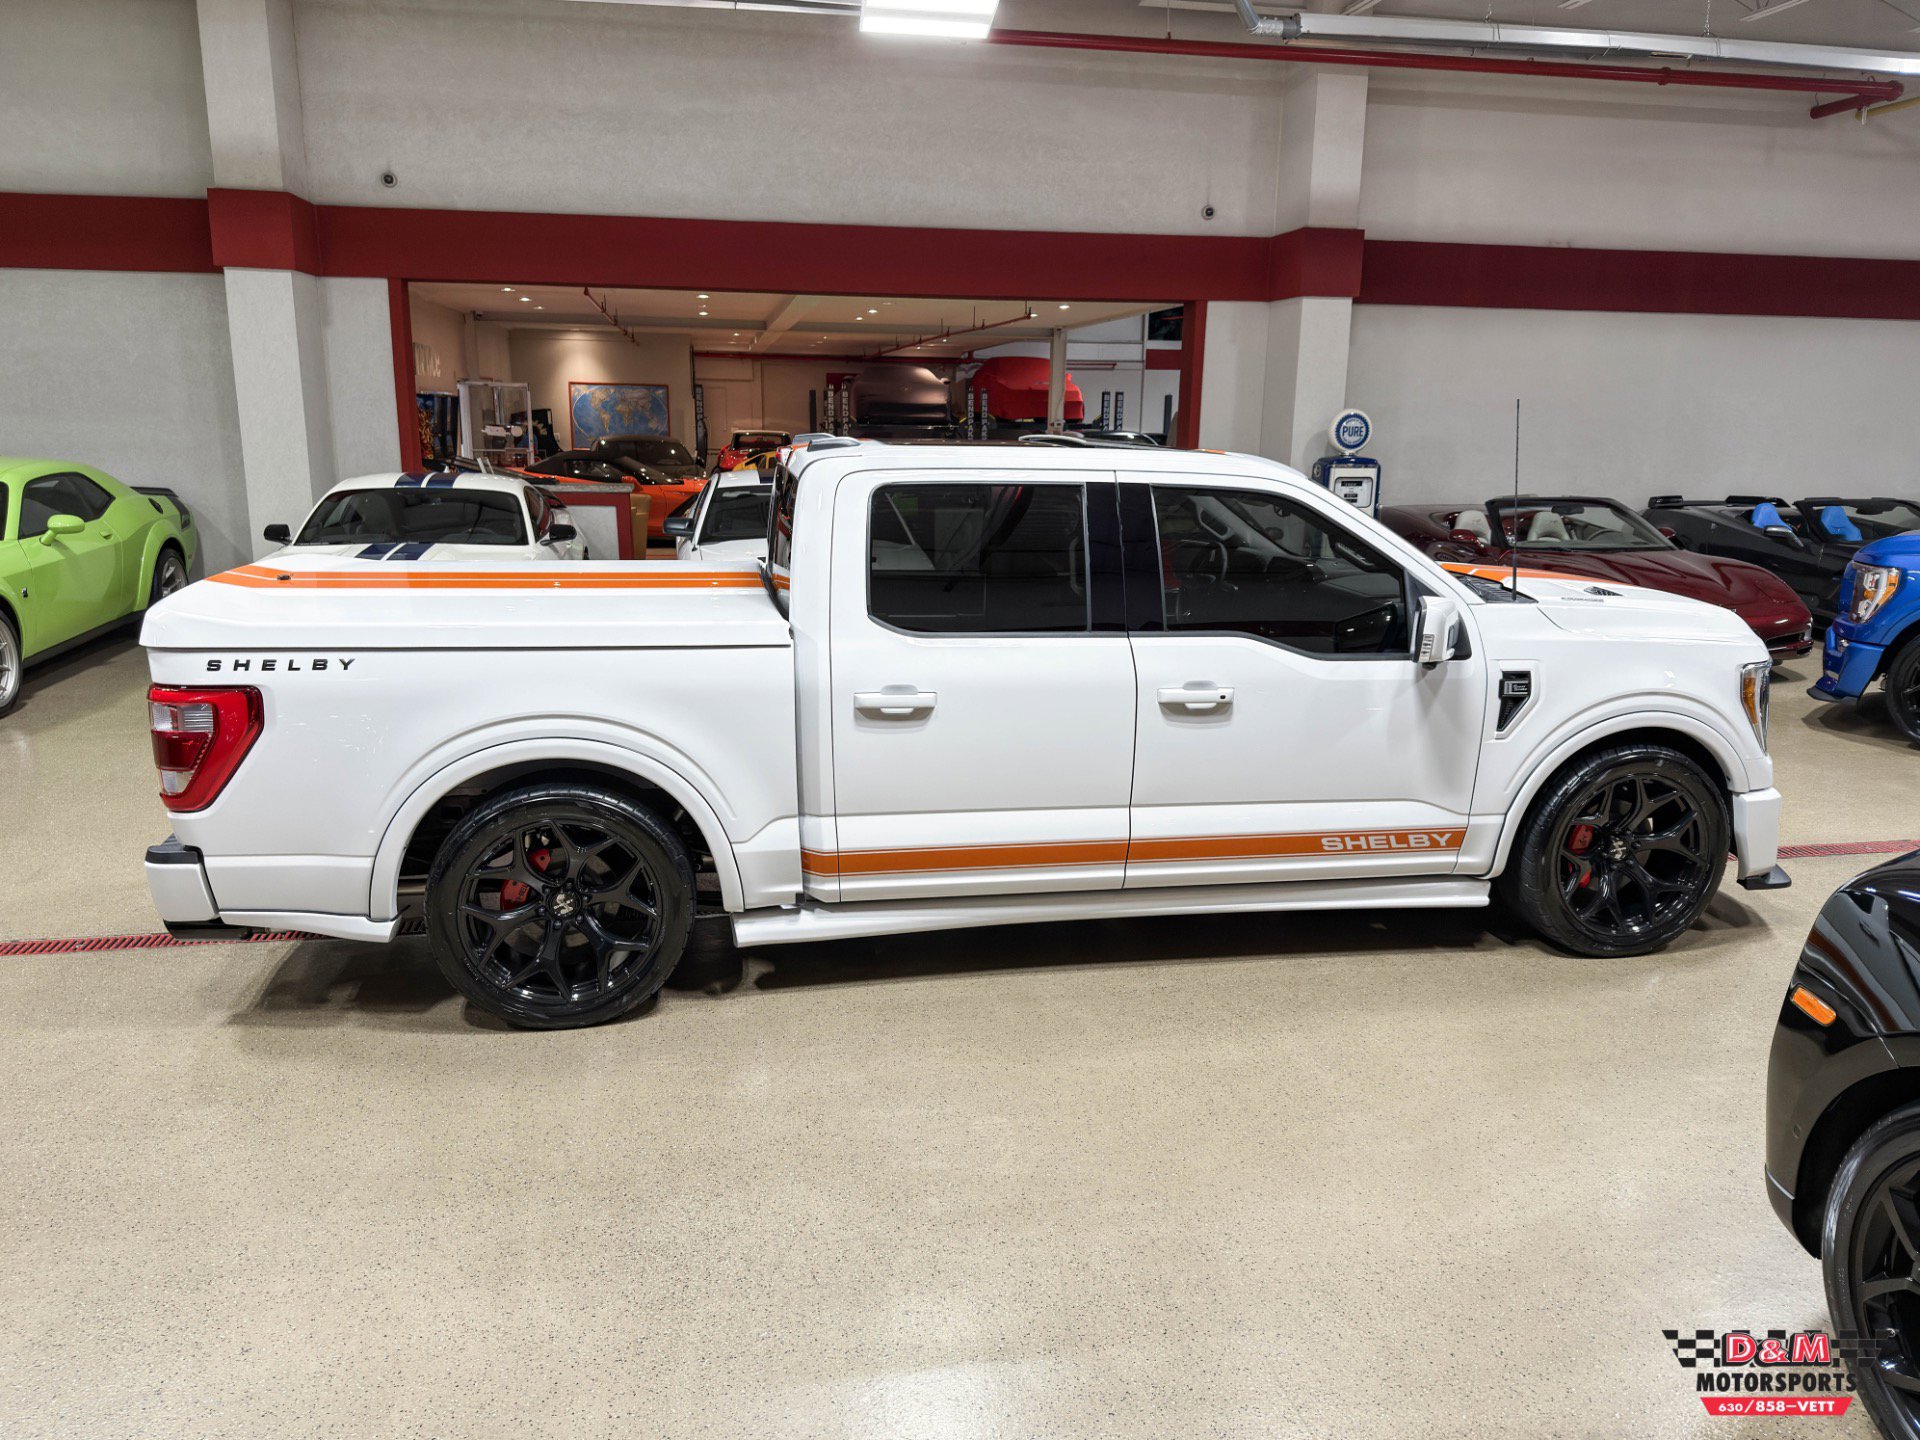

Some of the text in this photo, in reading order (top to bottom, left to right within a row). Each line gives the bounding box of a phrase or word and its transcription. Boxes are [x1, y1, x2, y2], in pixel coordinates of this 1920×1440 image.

[1342, 426, 1364, 437] PURE
[206, 658, 355, 672] SHELBY
[1321, 833, 1452, 851] SHELBY
